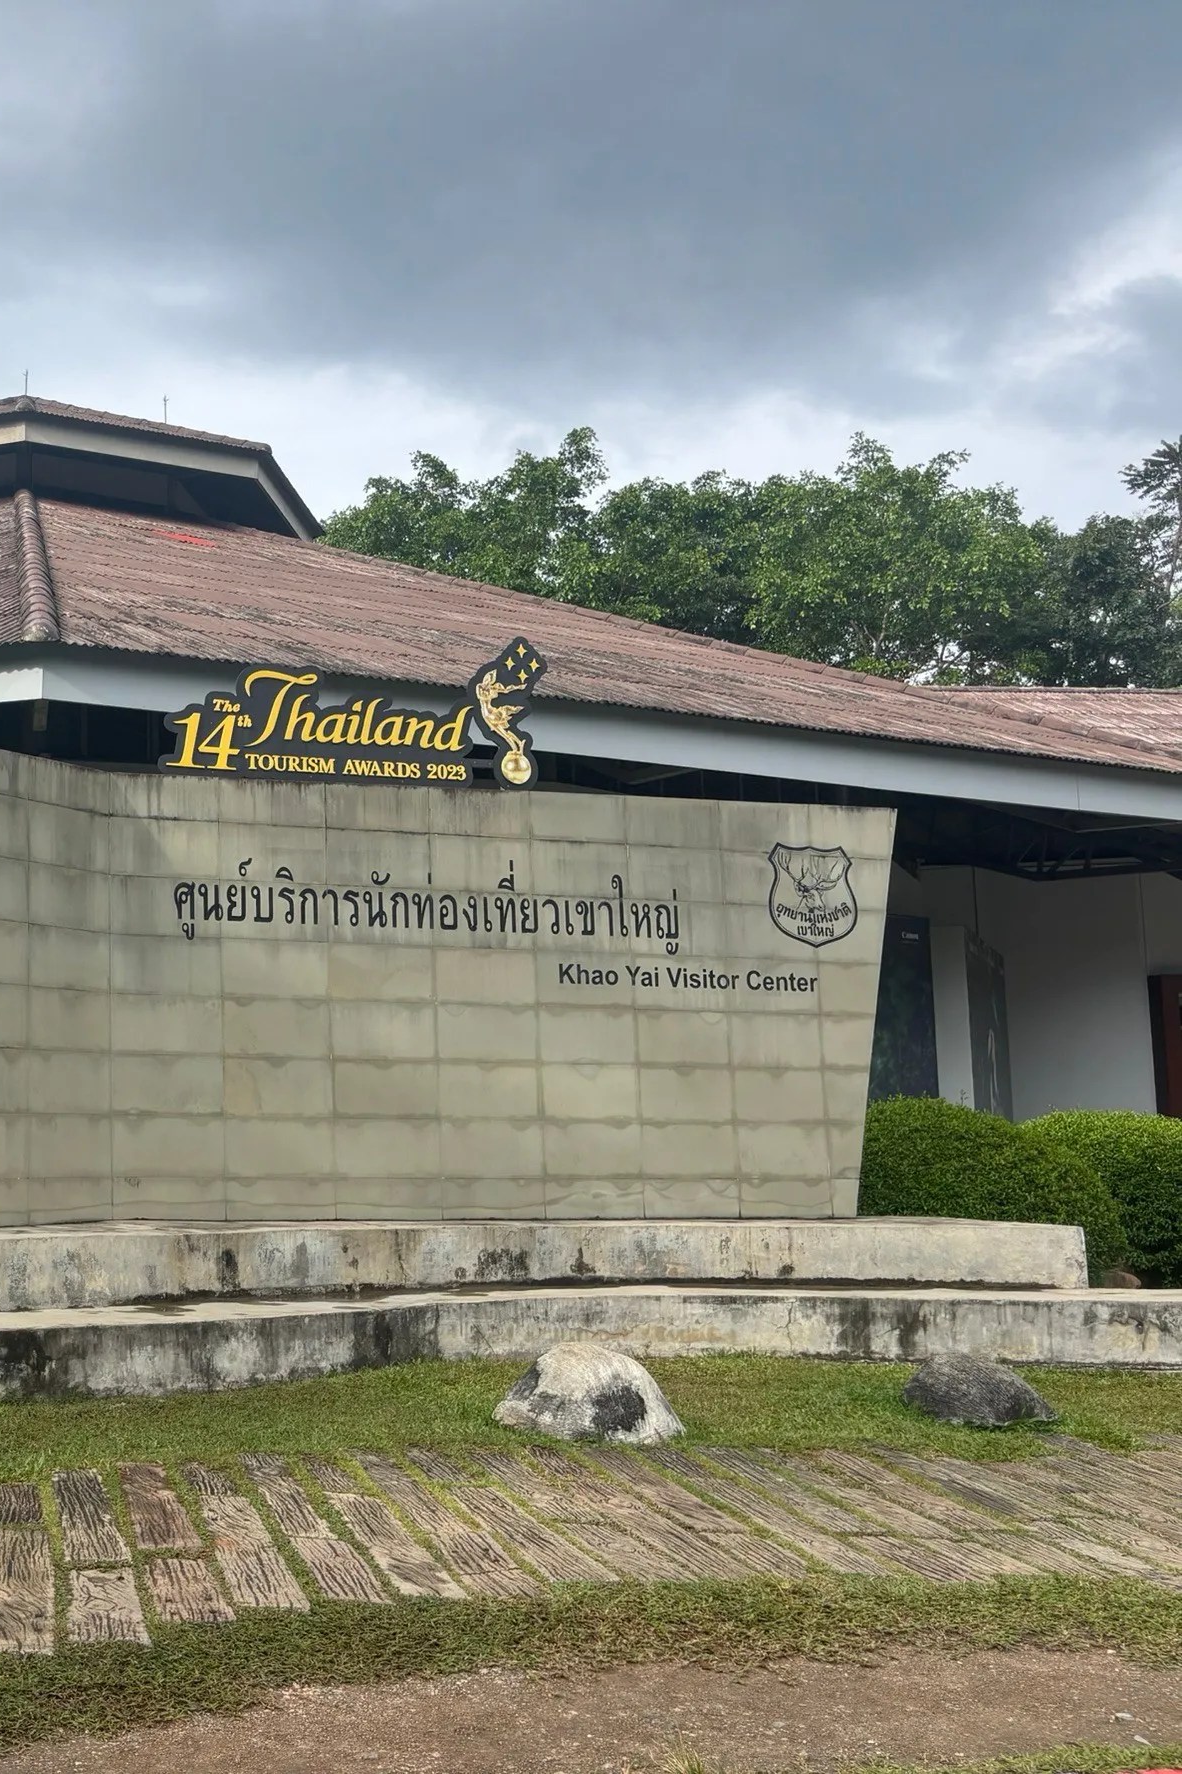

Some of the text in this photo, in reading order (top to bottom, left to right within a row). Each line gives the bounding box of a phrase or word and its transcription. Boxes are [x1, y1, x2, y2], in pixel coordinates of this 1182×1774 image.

[213, 699, 240, 713] The
[243, 669, 474, 751] Thailand
[245, 754, 466, 781] TOURISM AWARDS 2023
[173, 858, 680, 955] ศูนย์บริการนักท่องเที่ยวเขาใหญ่
[775, 902, 852, 924] อุทยานแห่งชาติ
[797, 923, 835, 938] เขาใหญ่
[558, 963, 818, 993] Khao Yai Visitor Center
